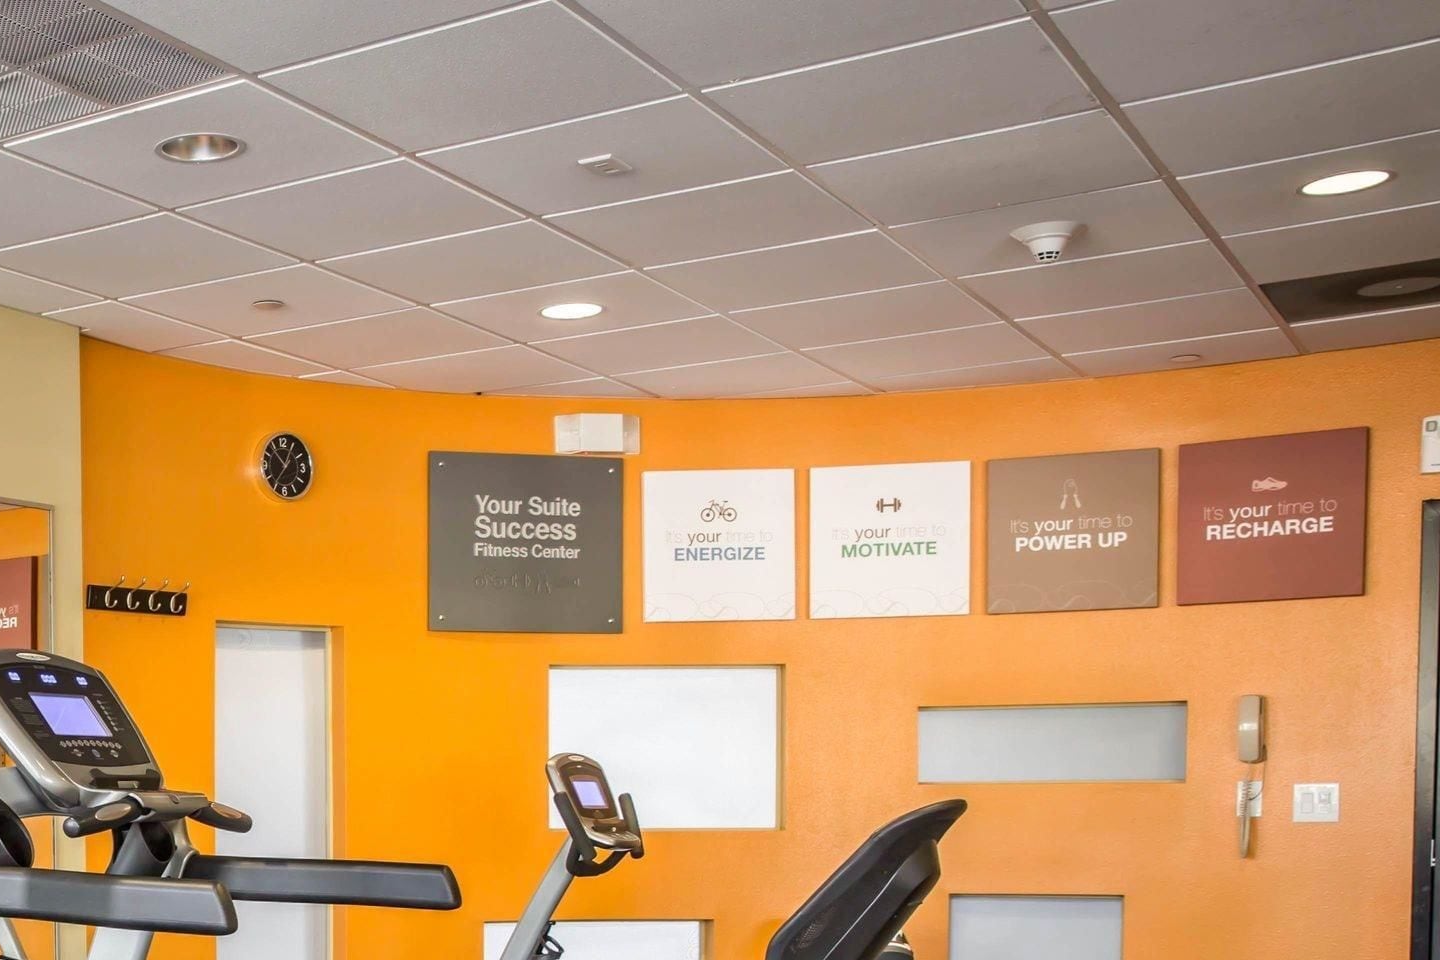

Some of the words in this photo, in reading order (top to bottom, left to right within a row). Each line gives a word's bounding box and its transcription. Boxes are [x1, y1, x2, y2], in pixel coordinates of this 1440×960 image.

[278, 437, 288, 448] 12
[299, 463, 306, 473] 3
[281, 486, 288, 496] 6
[474, 494, 523, 515] Your
[528, 496, 581, 517] Suite
[1203, 506, 1224, 521] It's
[1229, 505, 1273, 523] your
[1277, 500, 1314, 516] time
[1319, 498, 1338, 512] to
[474, 515, 577, 541] Success
[1009, 519, 1029, 534] It's
[1034, 519, 1074, 536] your
[1078, 515, 1112, 530] time
[1116, 513, 1133, 528] to
[1205, 515, 1335, 541] RECHARGE
[687, 532, 722, 547] your
[854, 527, 892, 543] your
[1015, 533, 1092, 553] POWER
[1097, 531, 1128, 548] UP
[473, 542, 529, 558] Fitness
[531, 543, 581, 559] Center
[674, 546, 766, 561] ENERGIZE
[841, 540, 937, 558] MOTIVATE
